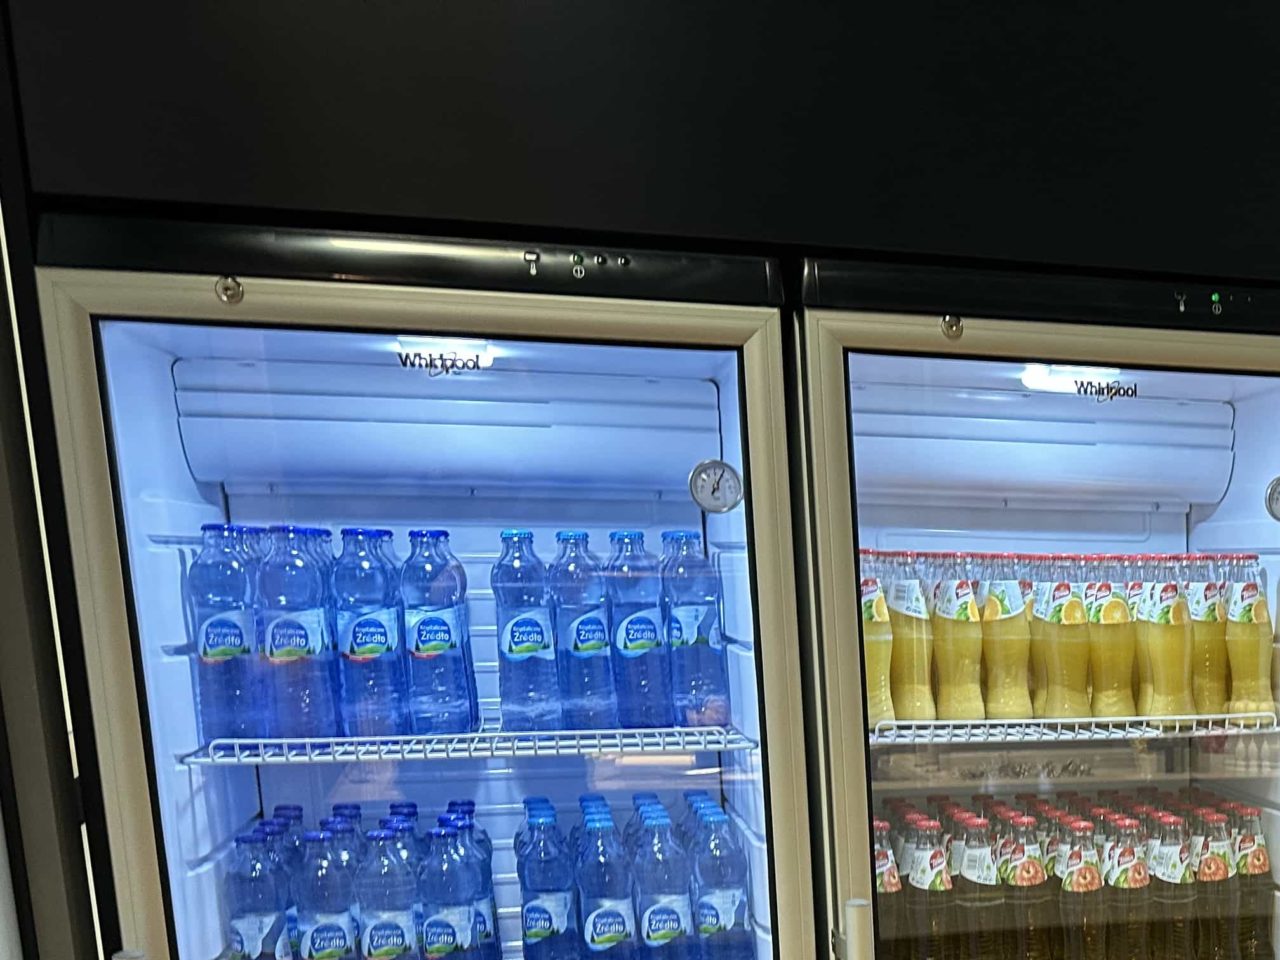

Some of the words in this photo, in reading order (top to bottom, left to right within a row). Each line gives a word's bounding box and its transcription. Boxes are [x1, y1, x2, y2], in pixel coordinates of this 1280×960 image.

[398, 353, 480, 374] Whirlpool
[1075, 380, 1137, 401] Whirlpool
[356, 633, 386, 644] Źródło
[421, 632, 450, 642] Źródło
[513, 632, 542, 642] Źródło
[628, 630, 656, 640] Źródło
